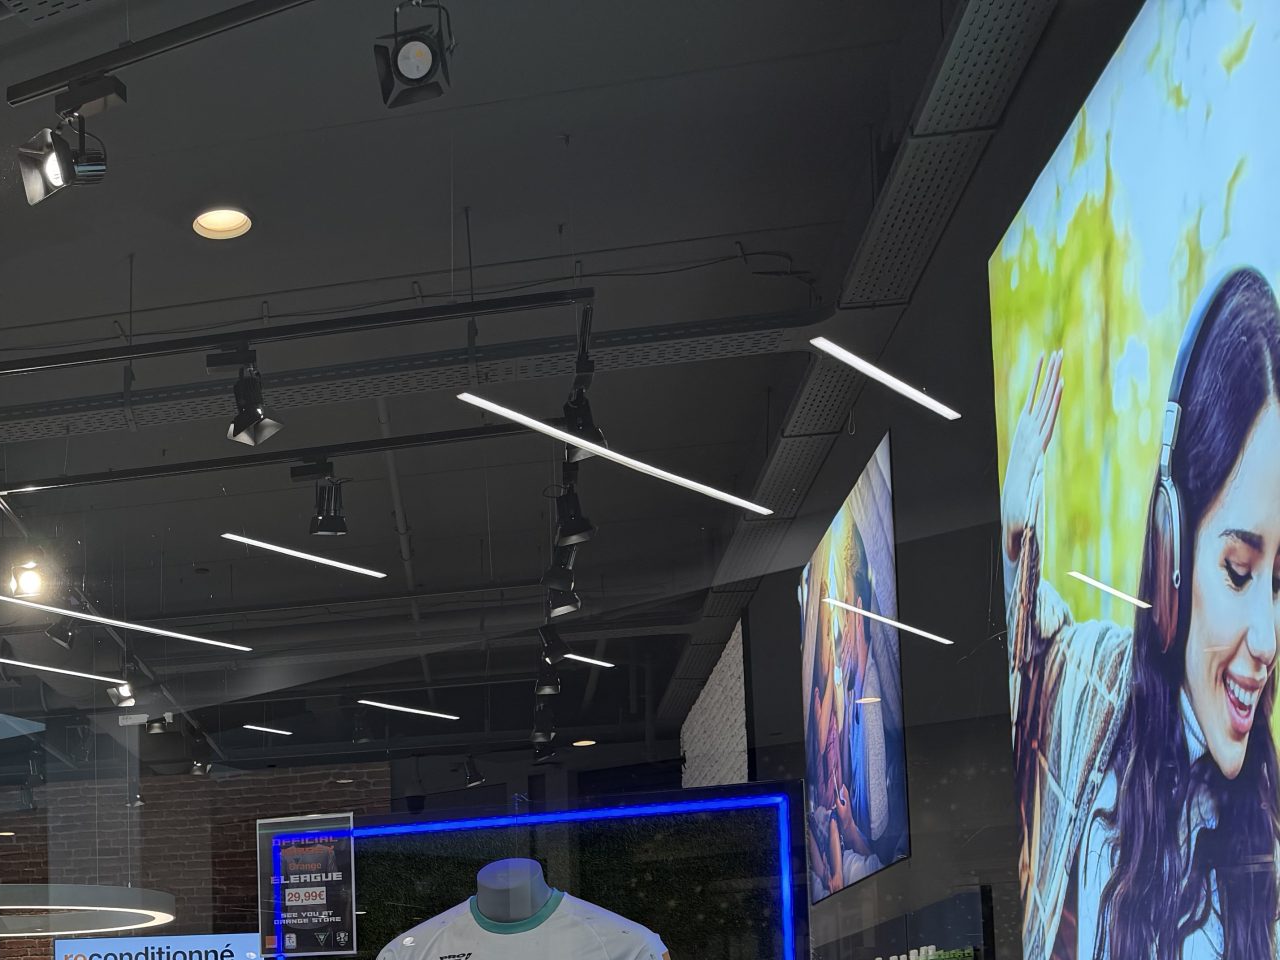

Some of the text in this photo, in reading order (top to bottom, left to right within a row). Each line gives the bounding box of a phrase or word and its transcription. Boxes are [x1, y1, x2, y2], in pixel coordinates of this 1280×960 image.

[289, 862, 322, 871] Orange
[270, 872, 343, 884] ELEAGUE
[287, 890, 325, 903] 29,99€
[280, 911, 298, 919] SEE
